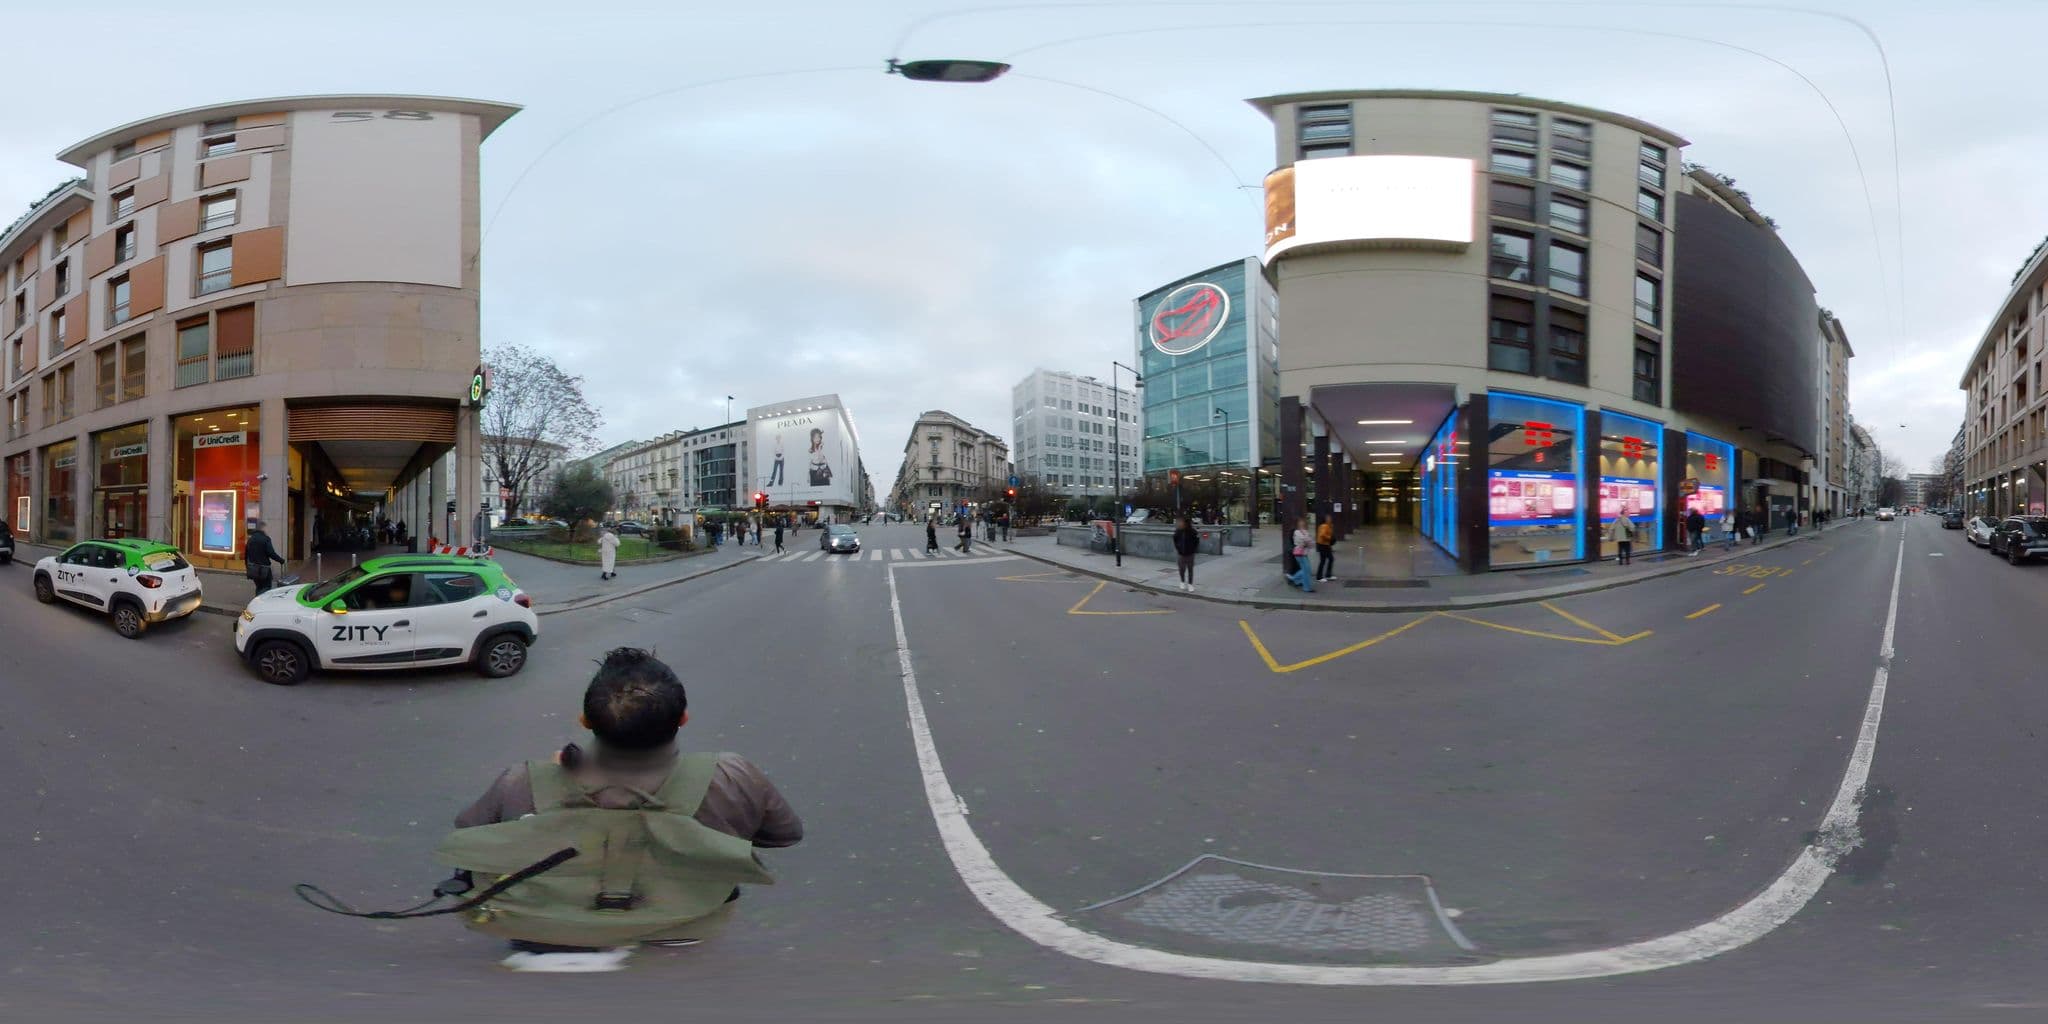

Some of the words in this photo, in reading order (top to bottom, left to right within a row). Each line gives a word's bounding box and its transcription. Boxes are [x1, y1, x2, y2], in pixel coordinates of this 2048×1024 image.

[777, 417, 814, 429] PRADA
[207, 435, 240, 445] UniCredit
[58, 570, 76, 583] ZITY
[332, 625, 389, 641] ZITY
